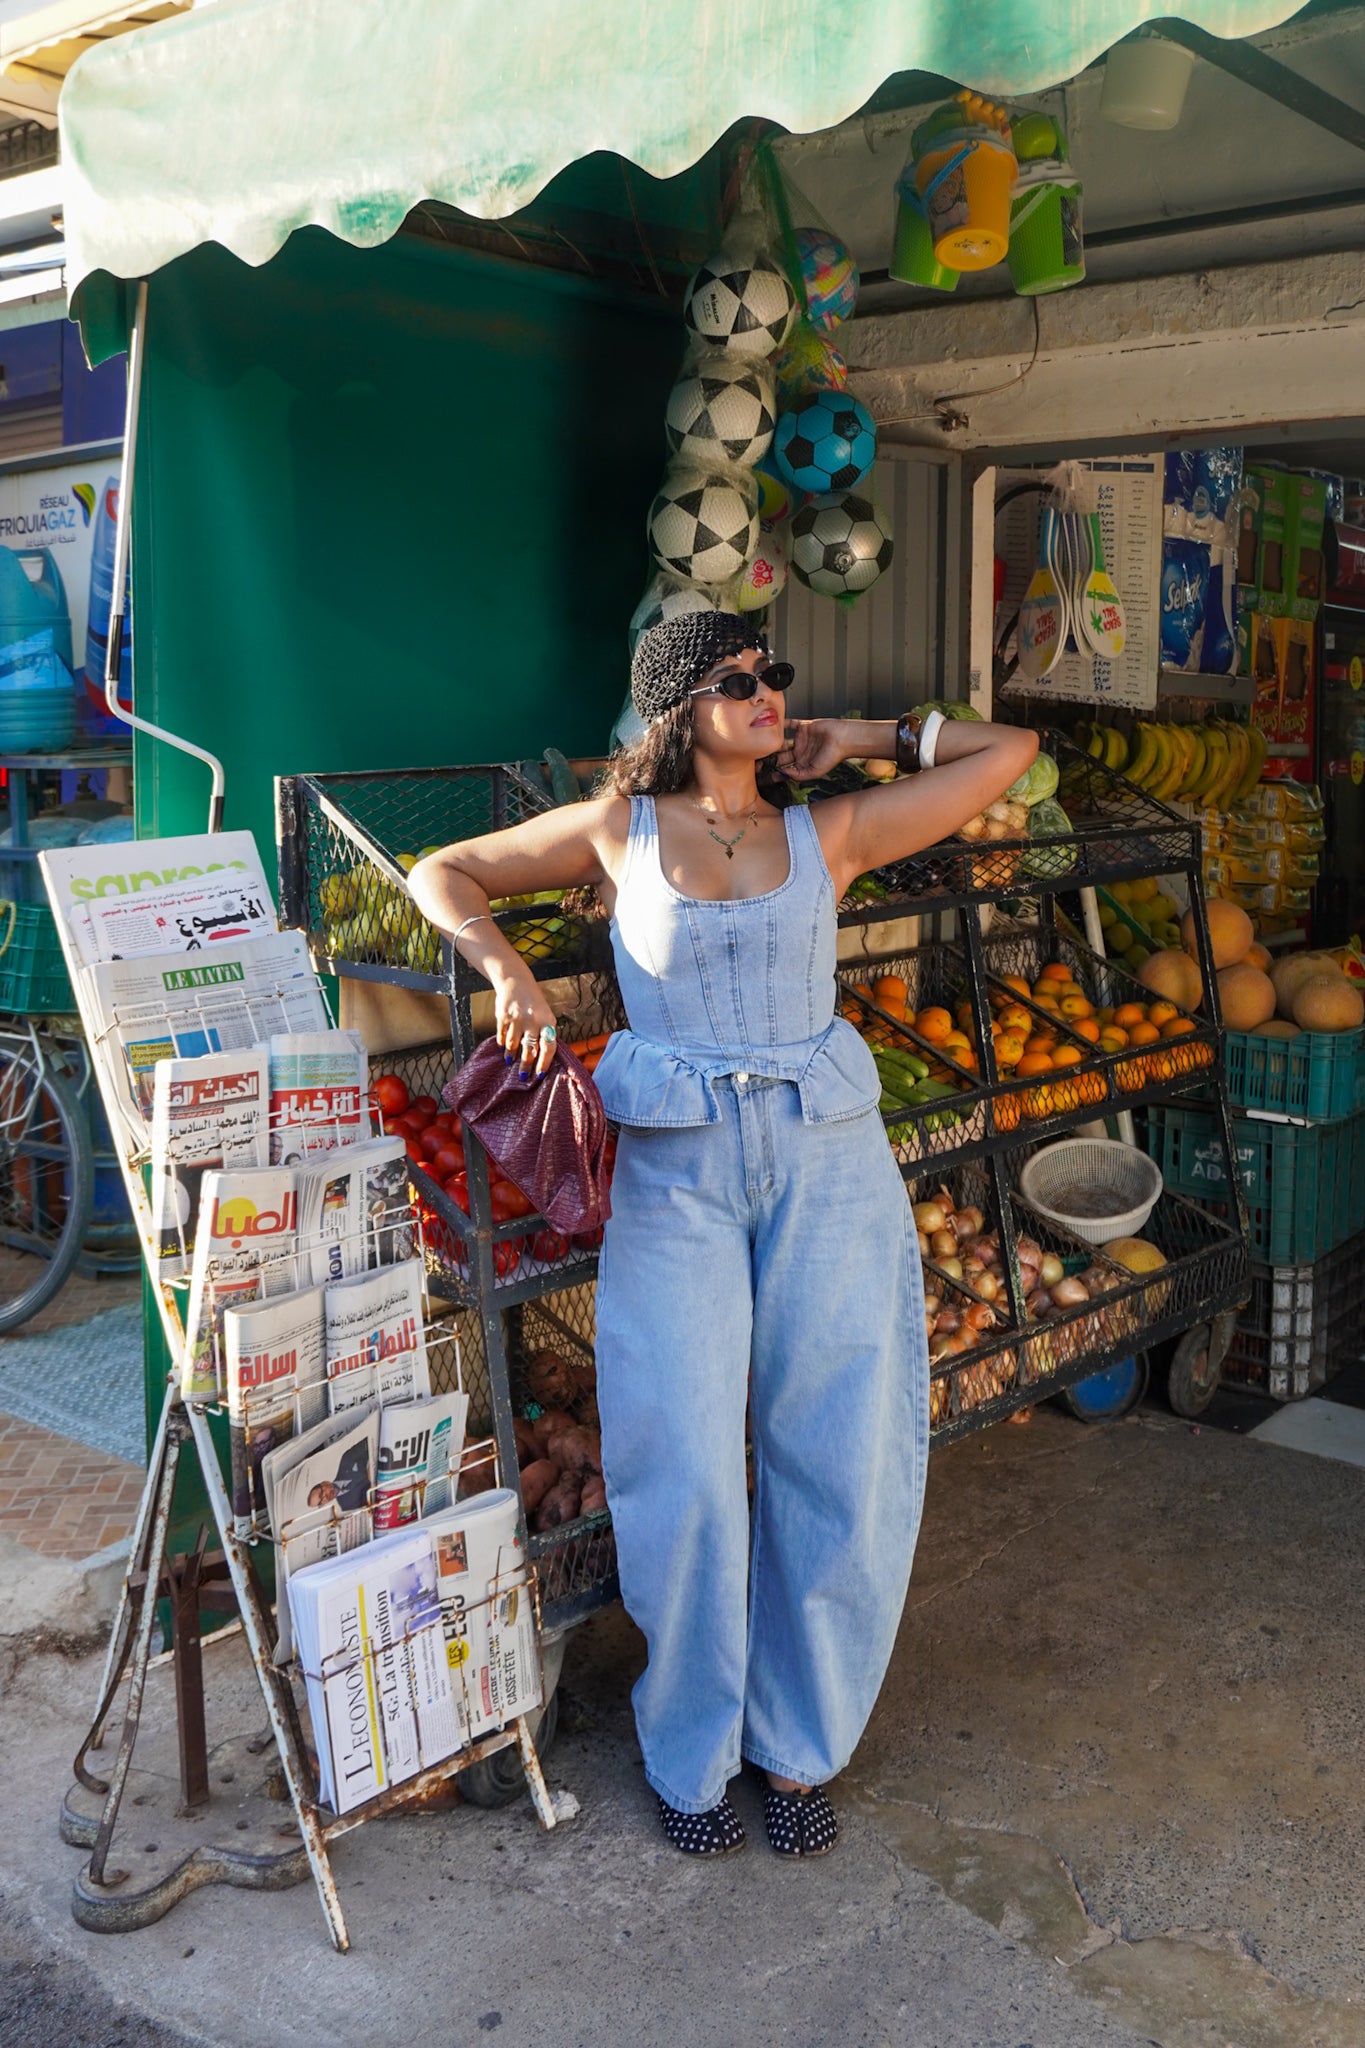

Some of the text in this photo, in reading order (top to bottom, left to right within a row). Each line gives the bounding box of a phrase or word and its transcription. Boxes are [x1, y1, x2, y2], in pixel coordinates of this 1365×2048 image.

[39, 494, 69, 509] RÉSEAU
[1102, 605, 1122, 633] BEACH BALL
[70, 860, 248, 904] sapr
[175, 895, 266, 938] الأسبوع
[166, 971, 187, 990] LE
[199, 1073, 258, 1104] الأحداث
[276, 1091, 354, 1126] الأخبار
[239, 1349, 297, 1388] رسالة
[449, 1645, 462, 1666] LES
[383, 1670, 398, 1699] La
[502, 1649, 518, 1706] CASSE-TÊTE
[388, 1698, 401, 1722] 5G:
